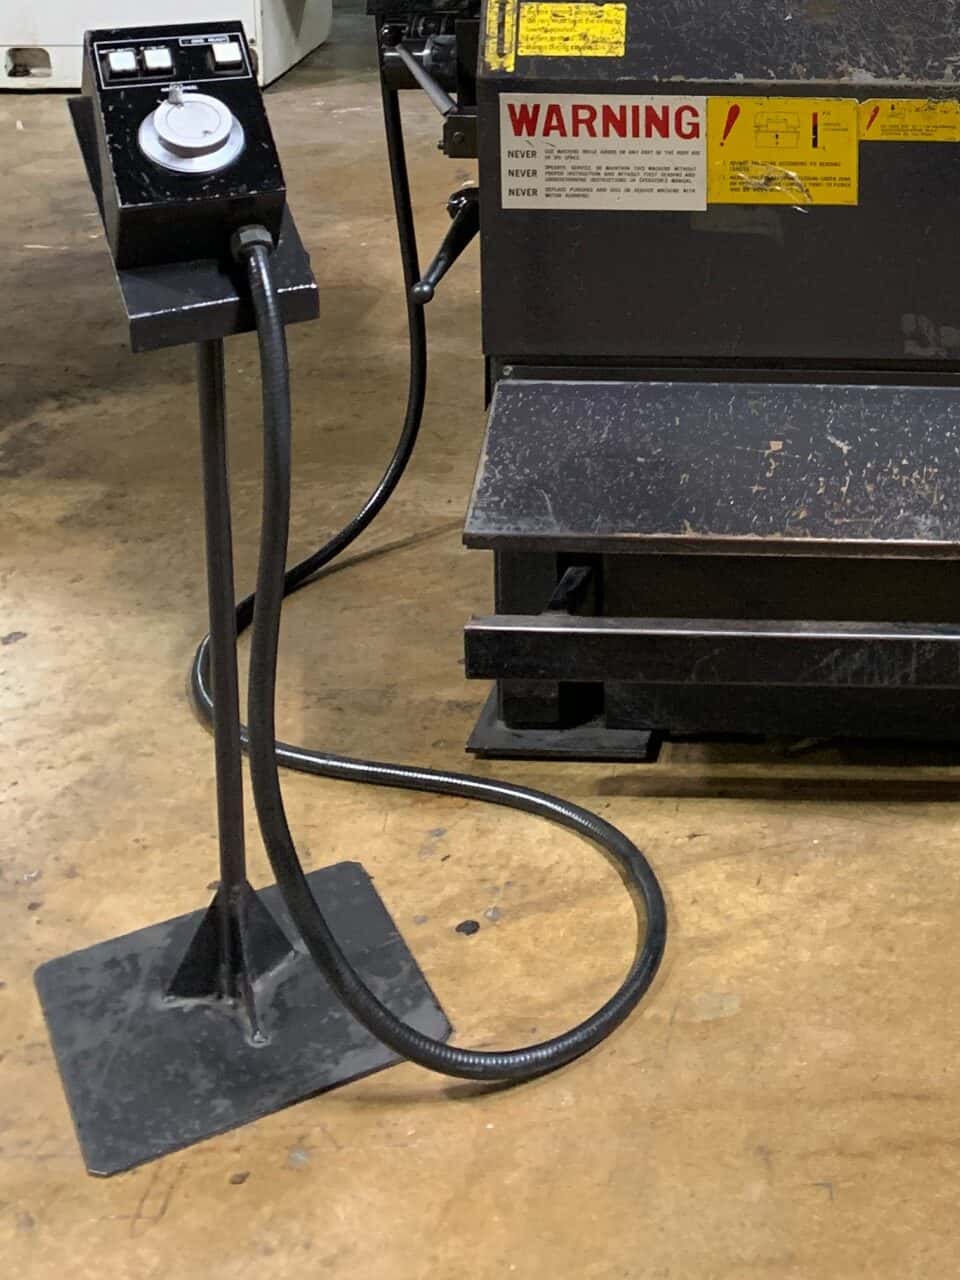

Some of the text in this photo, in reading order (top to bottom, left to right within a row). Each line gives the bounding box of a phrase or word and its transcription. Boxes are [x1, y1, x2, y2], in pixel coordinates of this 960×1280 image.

[507, 104, 701, 140] WARNING
[507, 150, 537, 159] NEVER
[507, 169, 538, 178] NEVER
[507, 188, 538, 197] NEVER
